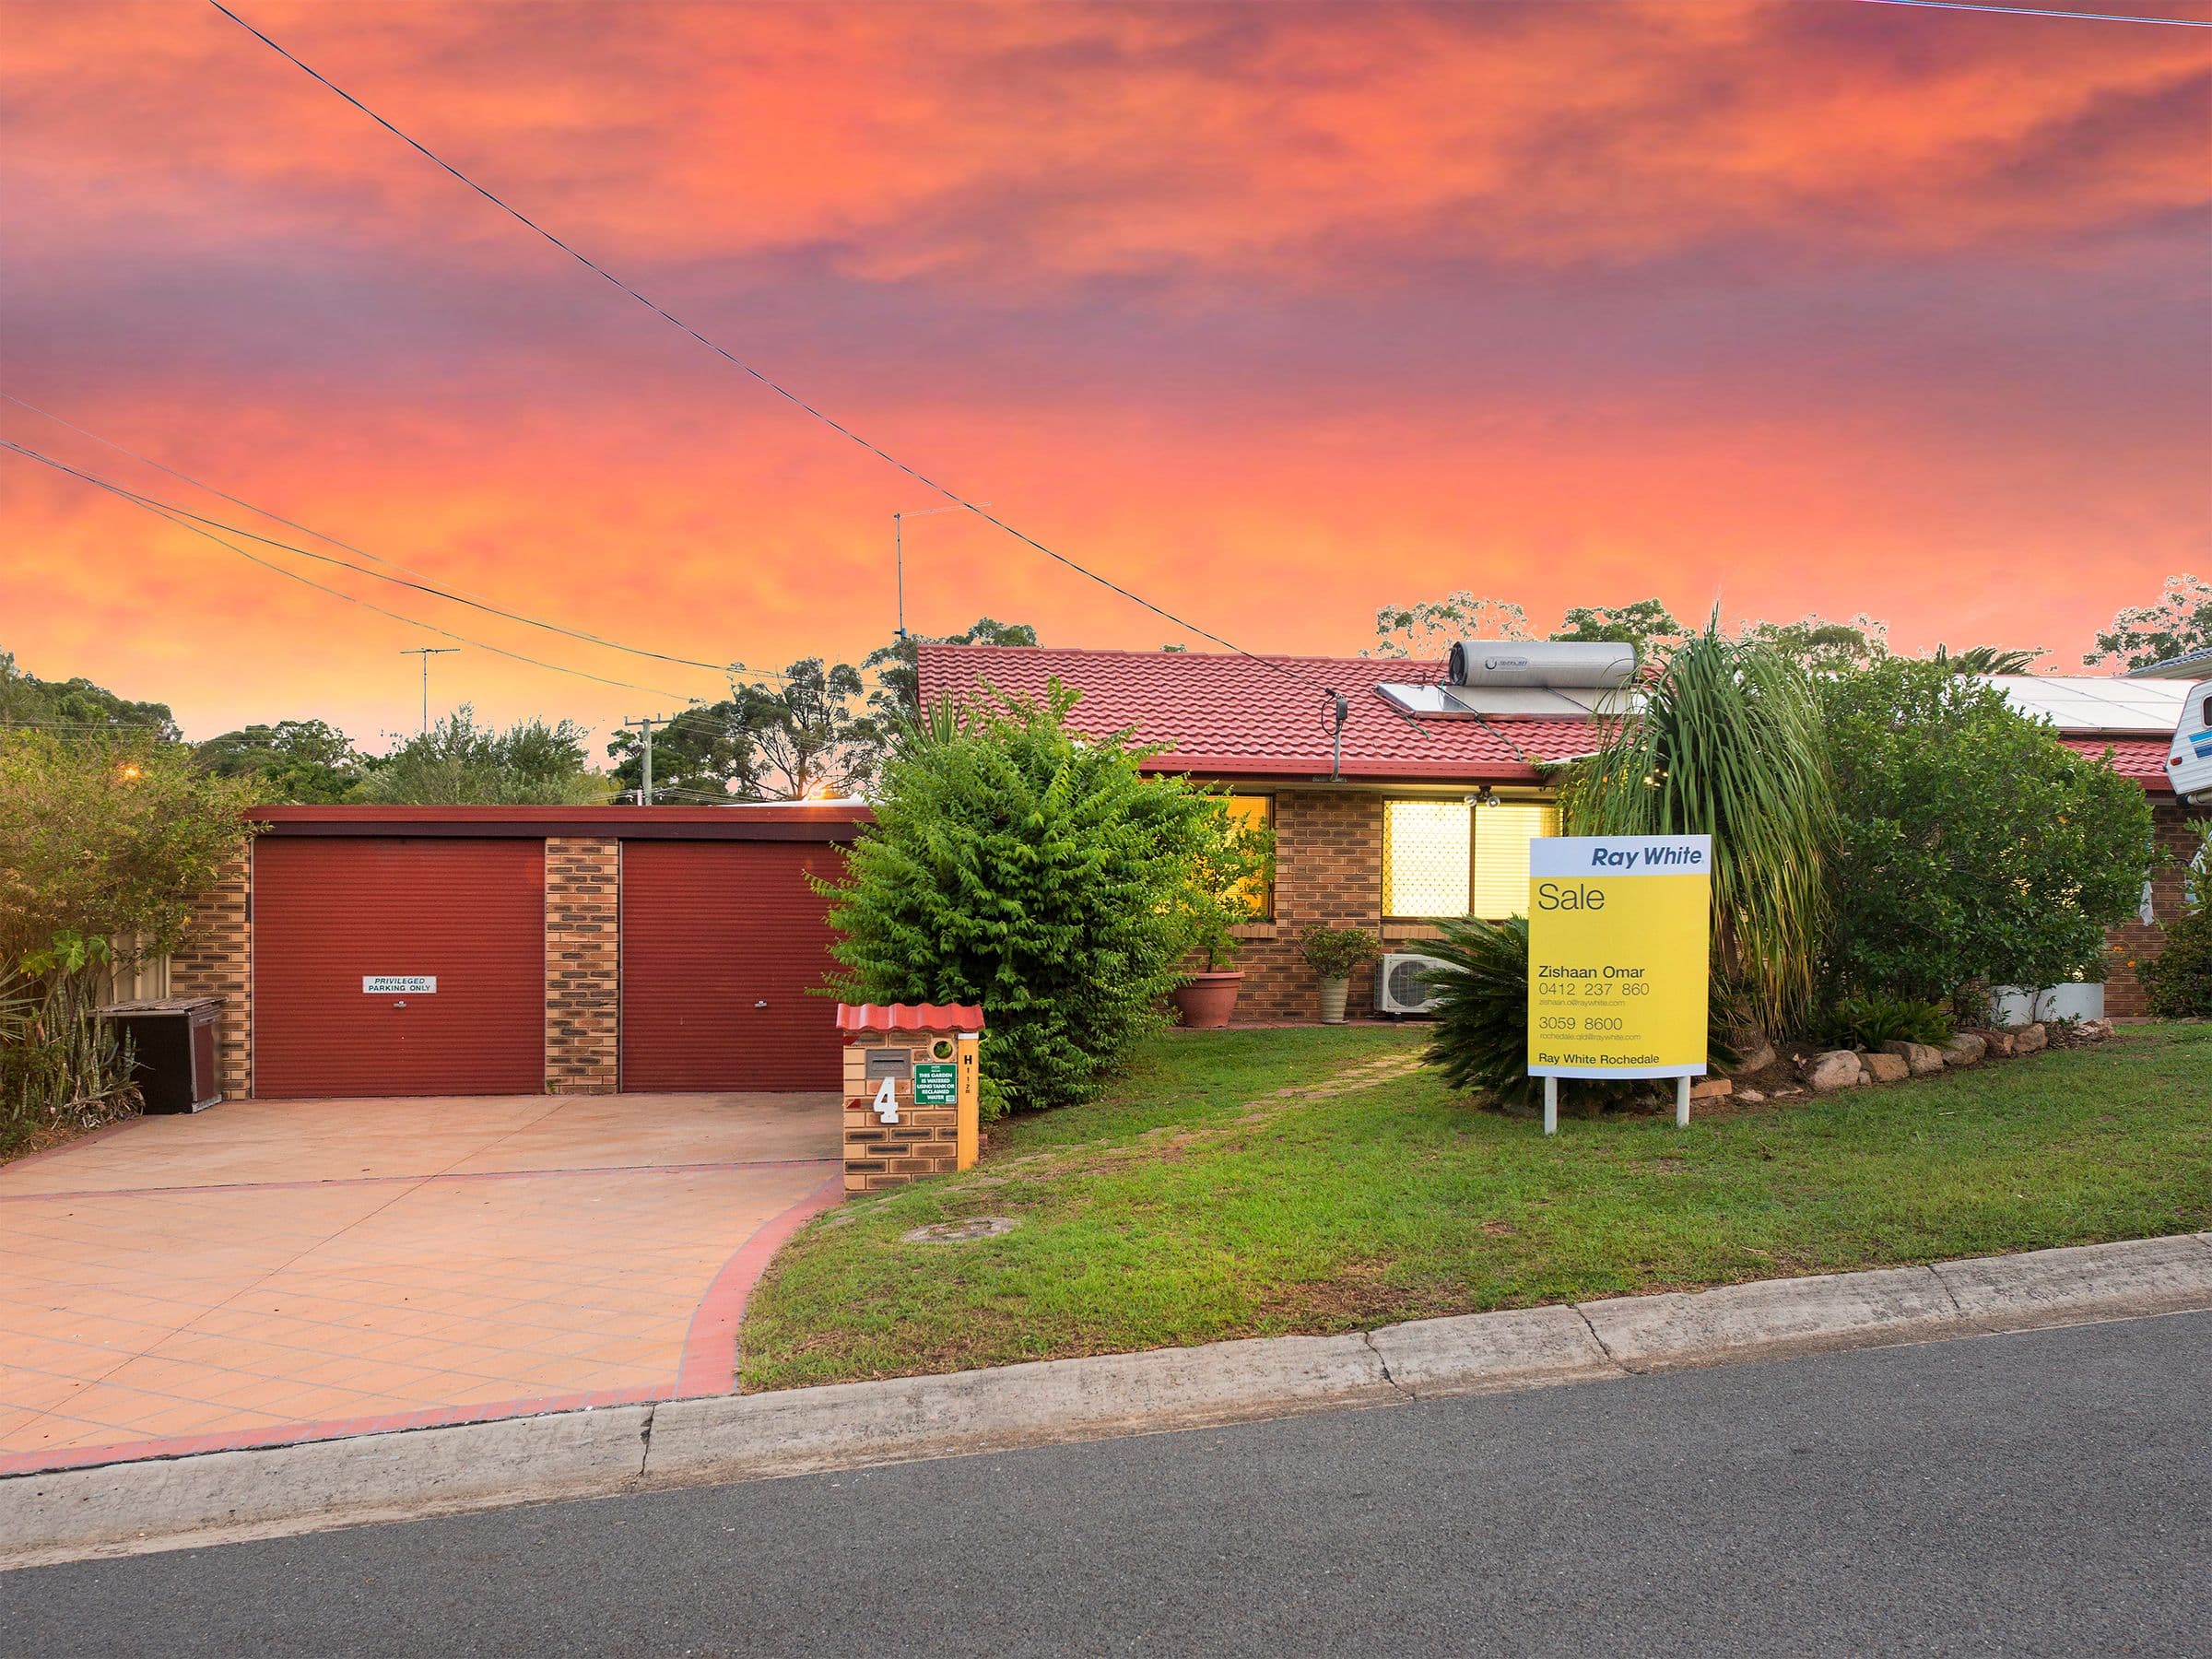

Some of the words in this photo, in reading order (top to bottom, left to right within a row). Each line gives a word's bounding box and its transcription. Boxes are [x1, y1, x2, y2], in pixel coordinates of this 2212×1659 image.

[1591, 848, 1639, 869] Ray
[1644, 846, 1702, 865] White
[1538, 883, 1606, 911] Sale
[1538, 965, 1597, 978] Zishaan
[1603, 965, 1645, 979] Omar
[1539, 982, 1576, 995] 0412
[1584, 982, 1613, 995] 237
[1622, 982, 1650, 995] 860
[1538, 1017, 1576, 1030] 3059
[1584, 1017, 1623, 1030] 8600
[1538, 1053, 1559, 1065] Ray
[1563, 1053, 1596, 1065] White
[1600, 1053, 1660, 1065] Rochedale
[873, 1077, 900, 1124] 4
